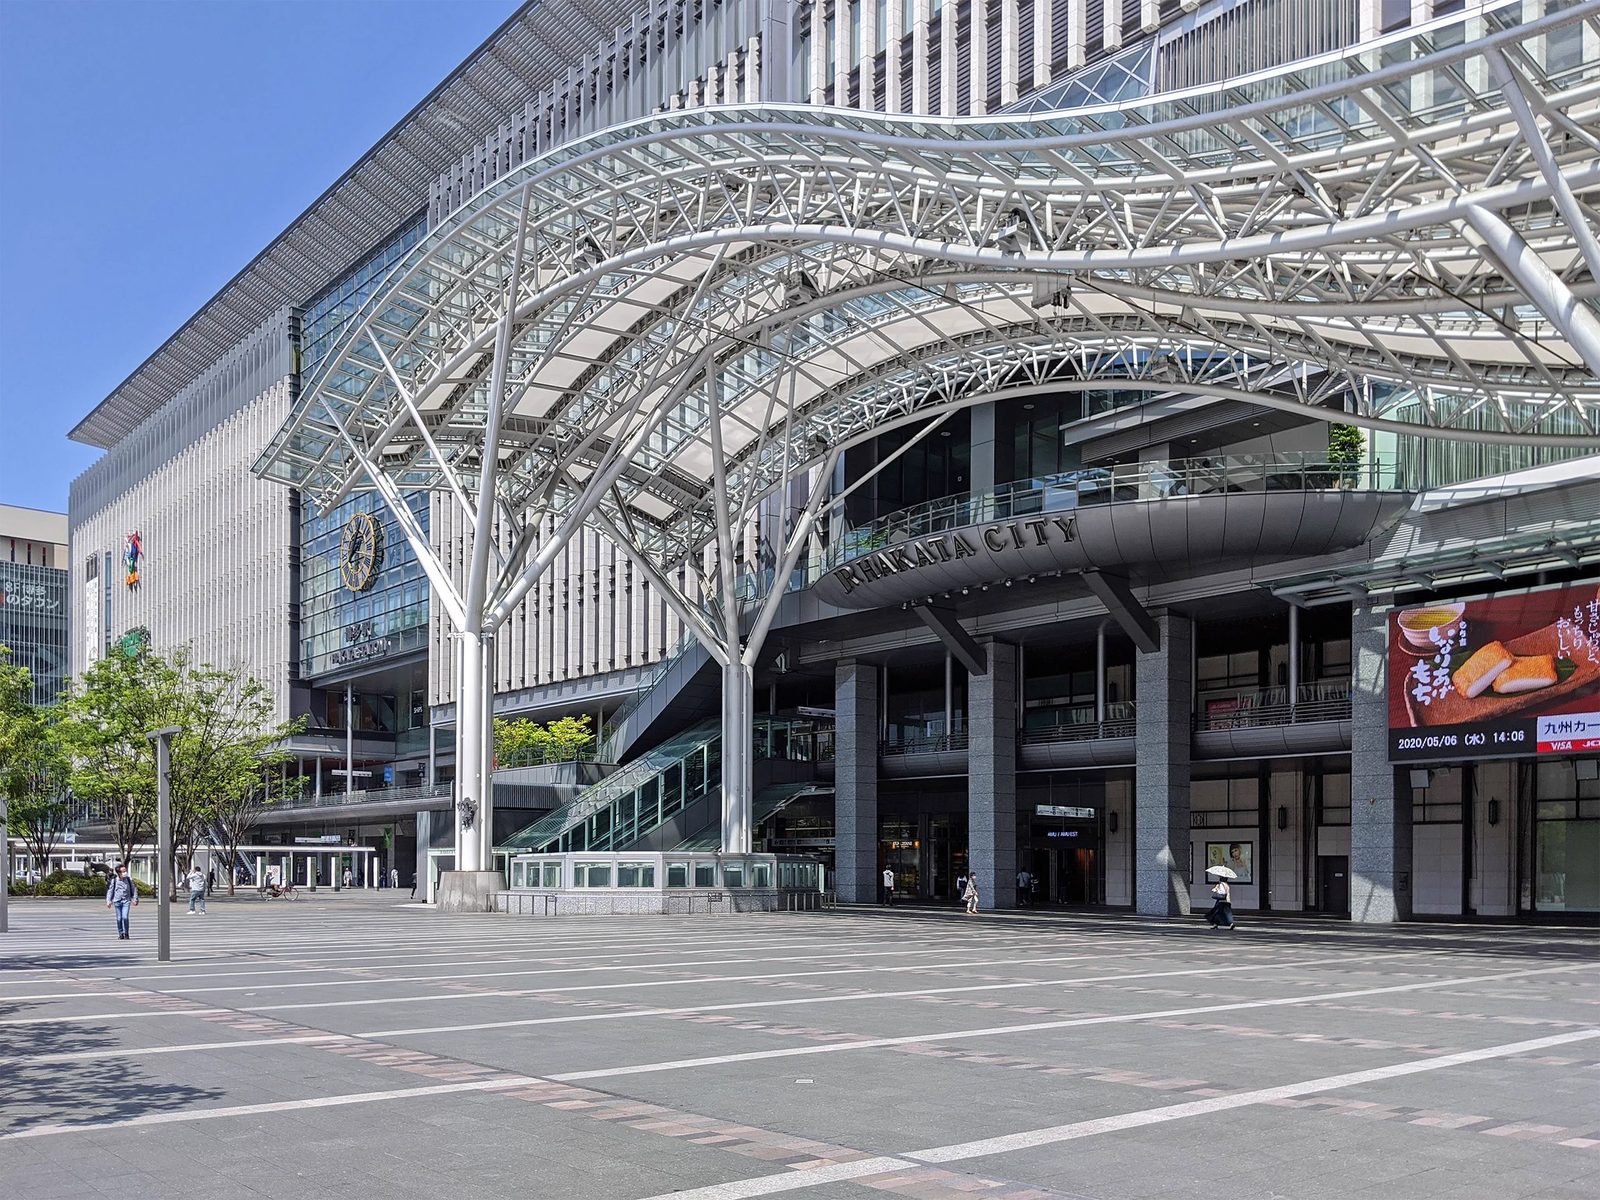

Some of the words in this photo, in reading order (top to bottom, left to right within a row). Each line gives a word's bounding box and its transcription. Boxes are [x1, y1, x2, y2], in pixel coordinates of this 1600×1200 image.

[856, 532, 976, 582] HAKATA
[983, 515, 1076, 553] CITY
[1556, 617, 1571, 660] おいしい
[1572, 605, 1584, 650] もっちり
[1410, 659, 1432, 706] もち
[1429, 626, 1455, 699] いなりあげ
[1398, 735, 1457, 750] 2020/05/06
[1493, 730, 1525, 743] 14:06
[1551, 741, 1572, 751] VISA
